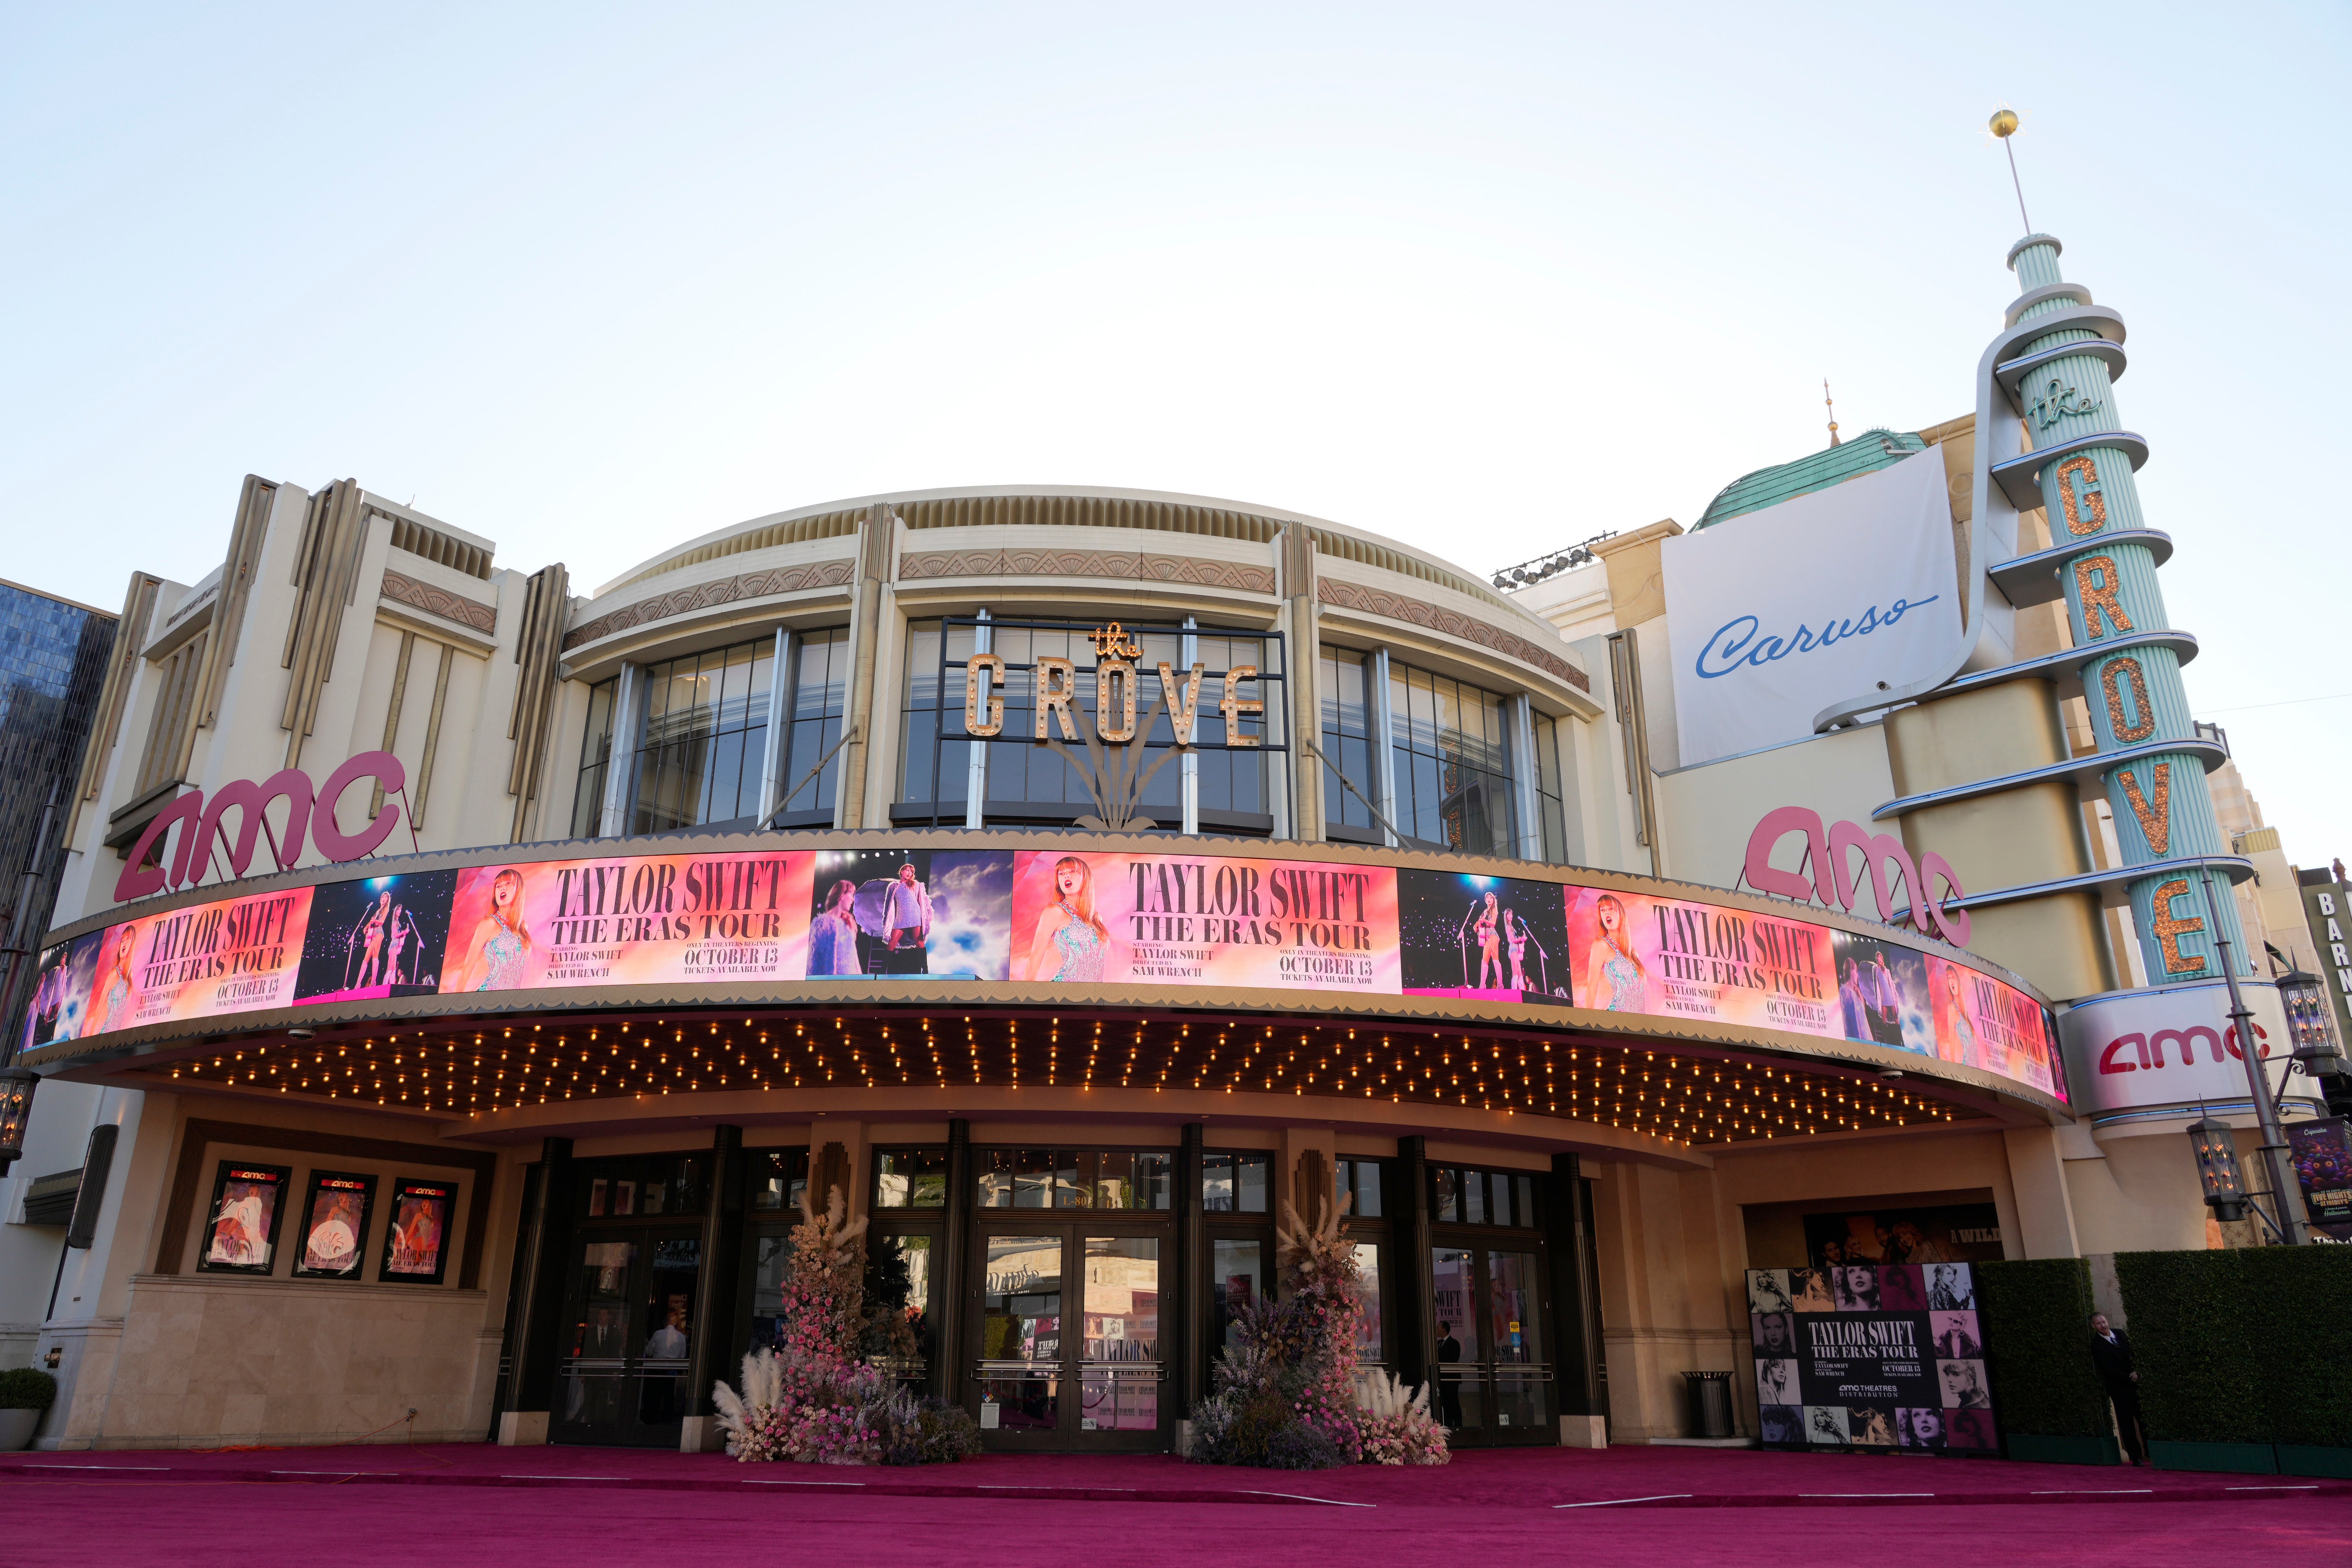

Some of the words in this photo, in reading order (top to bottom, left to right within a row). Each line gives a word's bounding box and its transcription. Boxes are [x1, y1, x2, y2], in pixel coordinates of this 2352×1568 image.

[2027, 379, 2102, 429] the
[1089, 622, 1145, 660] the
[1696, 595, 1939, 678] Caruso
[965, 654, 1263, 750] GROVE
[2055, 455, 2210, 976] GROVE
[556, 864, 676, 918] TAYLOR
[683, 860, 787, 913] SWIFT
[1130, 862, 1261, 917] TAYLOR
[1270, 868, 1369, 922] SWIFT
[148, 909, 223, 965] TAYLOR
[223, 897, 295, 951] SWIFT
[551, 919, 607, 945] THE
[613, 915, 691, 942] ERAS
[699, 913, 781, 939] TOUR
[1130, 916, 1194, 942] THE
[1201, 918, 1282, 946] ERAS
[1289, 922, 1372, 951] TOUR
[1653, 905, 1749, 964] TAYLOR
[1752, 920, 1816, 975] SWIFT
[550, 952, 591, 962] TAYLOR
[592, 950, 623, 960] SWIFT
[685, 948, 758, 965] OCTOBER
[765, 948, 778, 964] 13
[1132, 948, 1177, 959] TAYLOR
[1180, 950, 1214, 960] SWIFT
[2318, 893, 2352, 1019] BARN
[143, 963, 175, 989] THE
[177, 954, 226, 983] ERAS
[230, 947, 284, 975] TOUR
[547, 969, 567, 980] SAM
[570, 968, 609, 978] WRENCH
[1132, 966, 1154, 976] SAM
[1157, 967, 1202, 977] WRENCH
[1280, 956, 1354, 975] OCTOBER
[1359, 960, 1372, 976] 13
[1658, 954, 1707, 983] THE
[1710, 960, 1766, 990] ERAS
[1769, 970, 1823, 1000] TOUR
[218, 980, 266, 1000] OCTOBER
[268, 978, 279, 994] 13
[1314, 975, 1355, 983] AVAILABLE
[139, 992, 162, 1004] TAYLOR
[162, 989, 181, 1001] SWIFT
[235, 996, 264, 1006] AVAILABLE
[1664, 984, 1697, 996] TAYLOR
[1698, 988, 1722, 1000] SWIFT
[135, 1009, 147, 1020] SAM
[147, 1006, 171, 1017] WRENCH
[1666, 1001, 1682, 1011] SAM
[1684, 1003, 1716, 1014] WRENCH
[1767, 1000, 1814, 1021] OCTOBER
[1817, 1009, 1826, 1023] 13
[1972, 976, 2015, 1030] TAYLOR
[2013, 994, 2039, 1042] SWIFT
[1769, 1015, 1790, 1024] TICKETS
[1790, 1018, 1815, 1029] AVAILABLE
[1980, 1019, 2001, 1044] THE
[2001, 1024, 2024, 1053] ERAS
[2024, 1037, 2044, 1063] TOUR
[1063, 1196, 1086, 1206] L-80
[2312, 1193, 2327, 1203] FIVE
[2326, 1191, 2352, 1200] NIGHTS
[1950, 1230, 1958, 1243] A
[1958, 1228, 2001, 1243] WILD
[1439, 1308, 1461, 1316] TOUR
[1808, 1321, 1867, 1346] TAYLOR
[1868, 1321, 1915, 1346] SWIFT
[1811, 1346, 1839, 1358] THE
[1841, 1346, 1877, 1358] ERAS
[1879, 1346, 1919, 1358] TOUR
